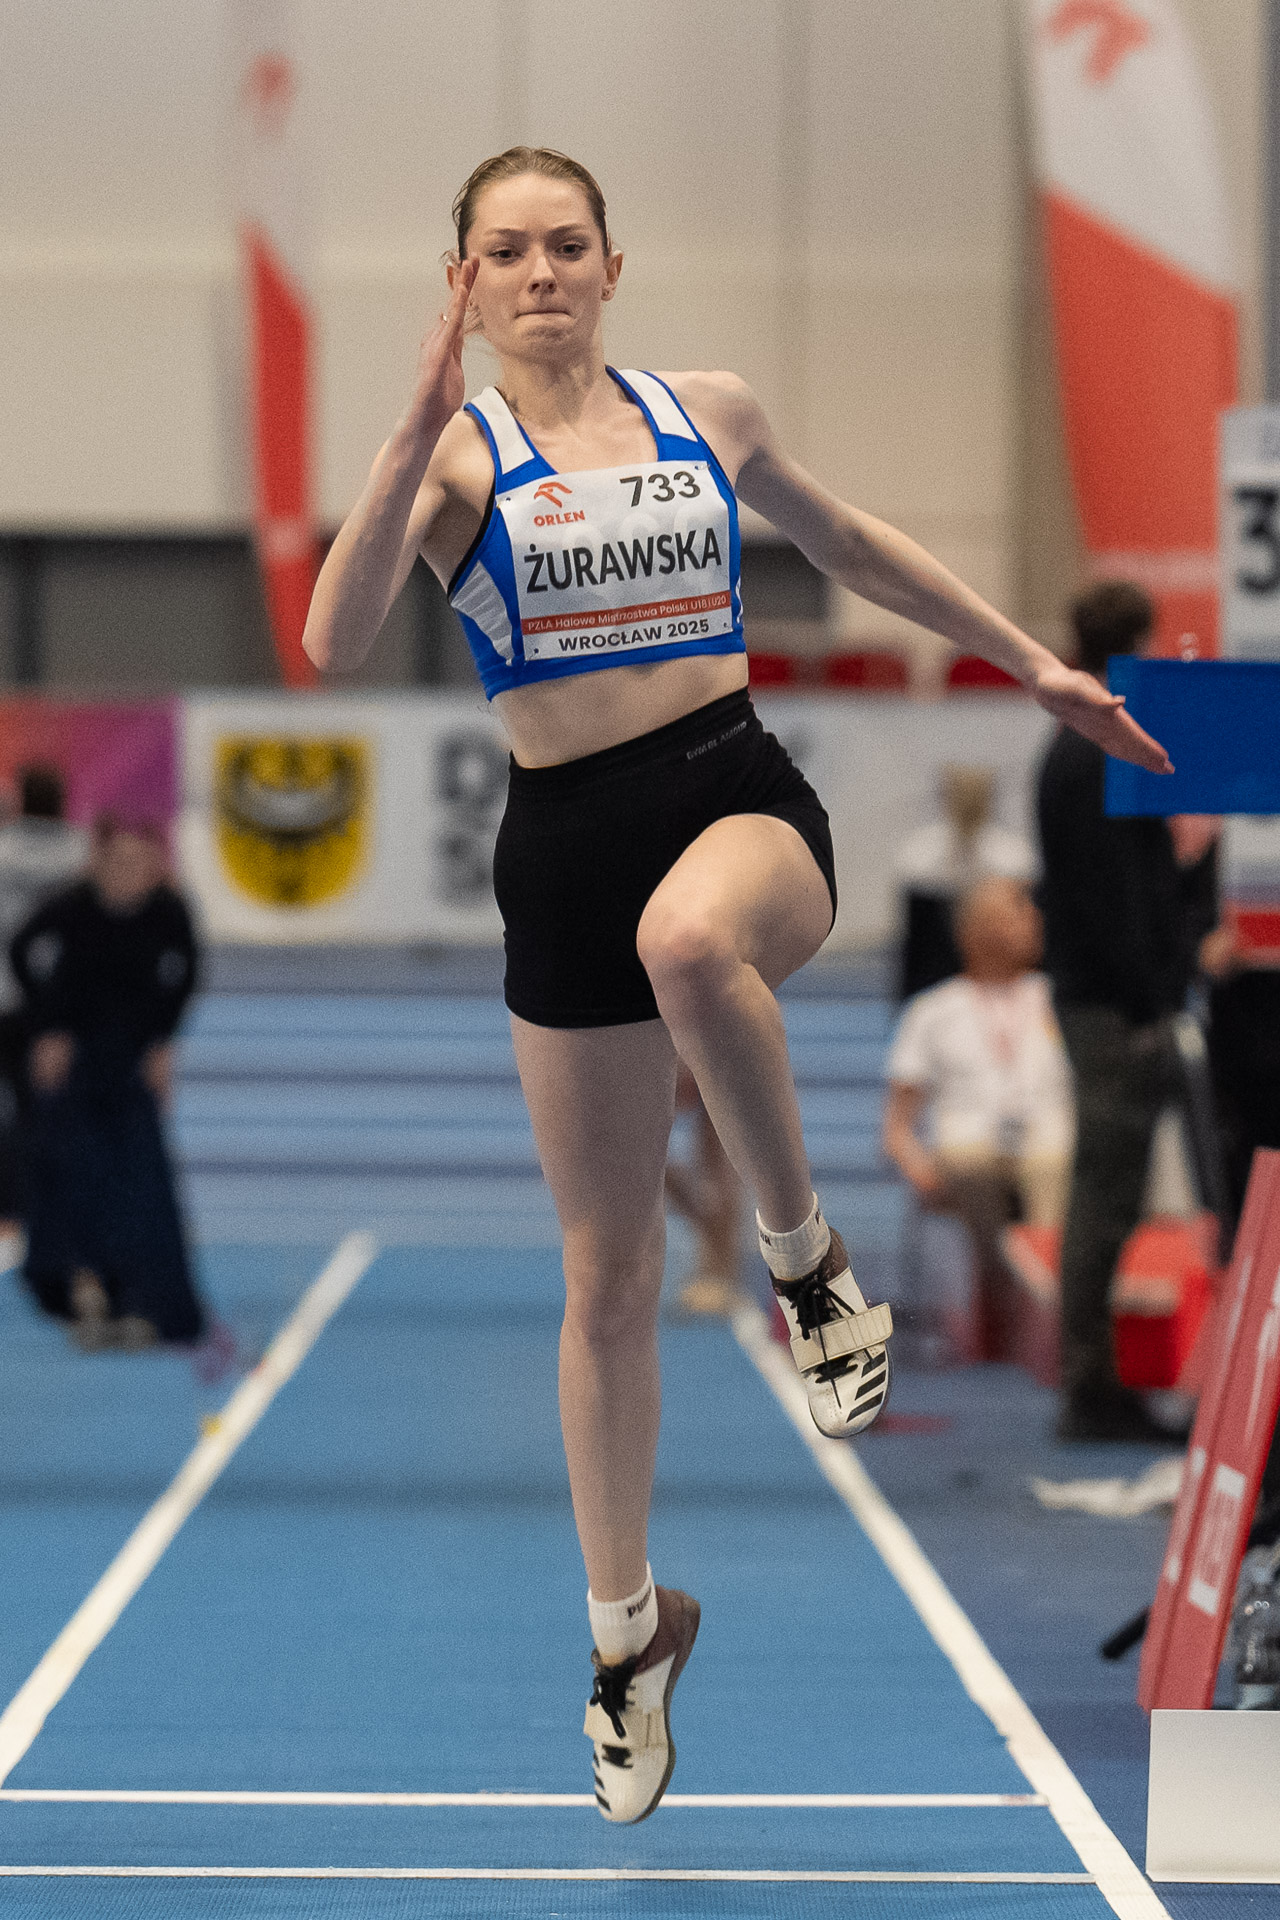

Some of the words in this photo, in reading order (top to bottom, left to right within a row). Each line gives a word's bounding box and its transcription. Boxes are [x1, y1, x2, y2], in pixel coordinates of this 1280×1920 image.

[619, 470, 701, 508] 733
[533, 509, 586, 527] ORLEN
[524, 527, 722, 594] ŻURAWSKA
[527, 619, 553, 632] PZLA
[555, 615, 596, 629] Halowe
[598, 608, 658, 624] Mistrzostwa
[659, 602, 689, 615] Polski
[690, 598, 708, 610] U18
[711, 594, 727, 607] U20
[558, 625, 662, 652] WROCŁAW
[666, 618, 710, 638] 2025
